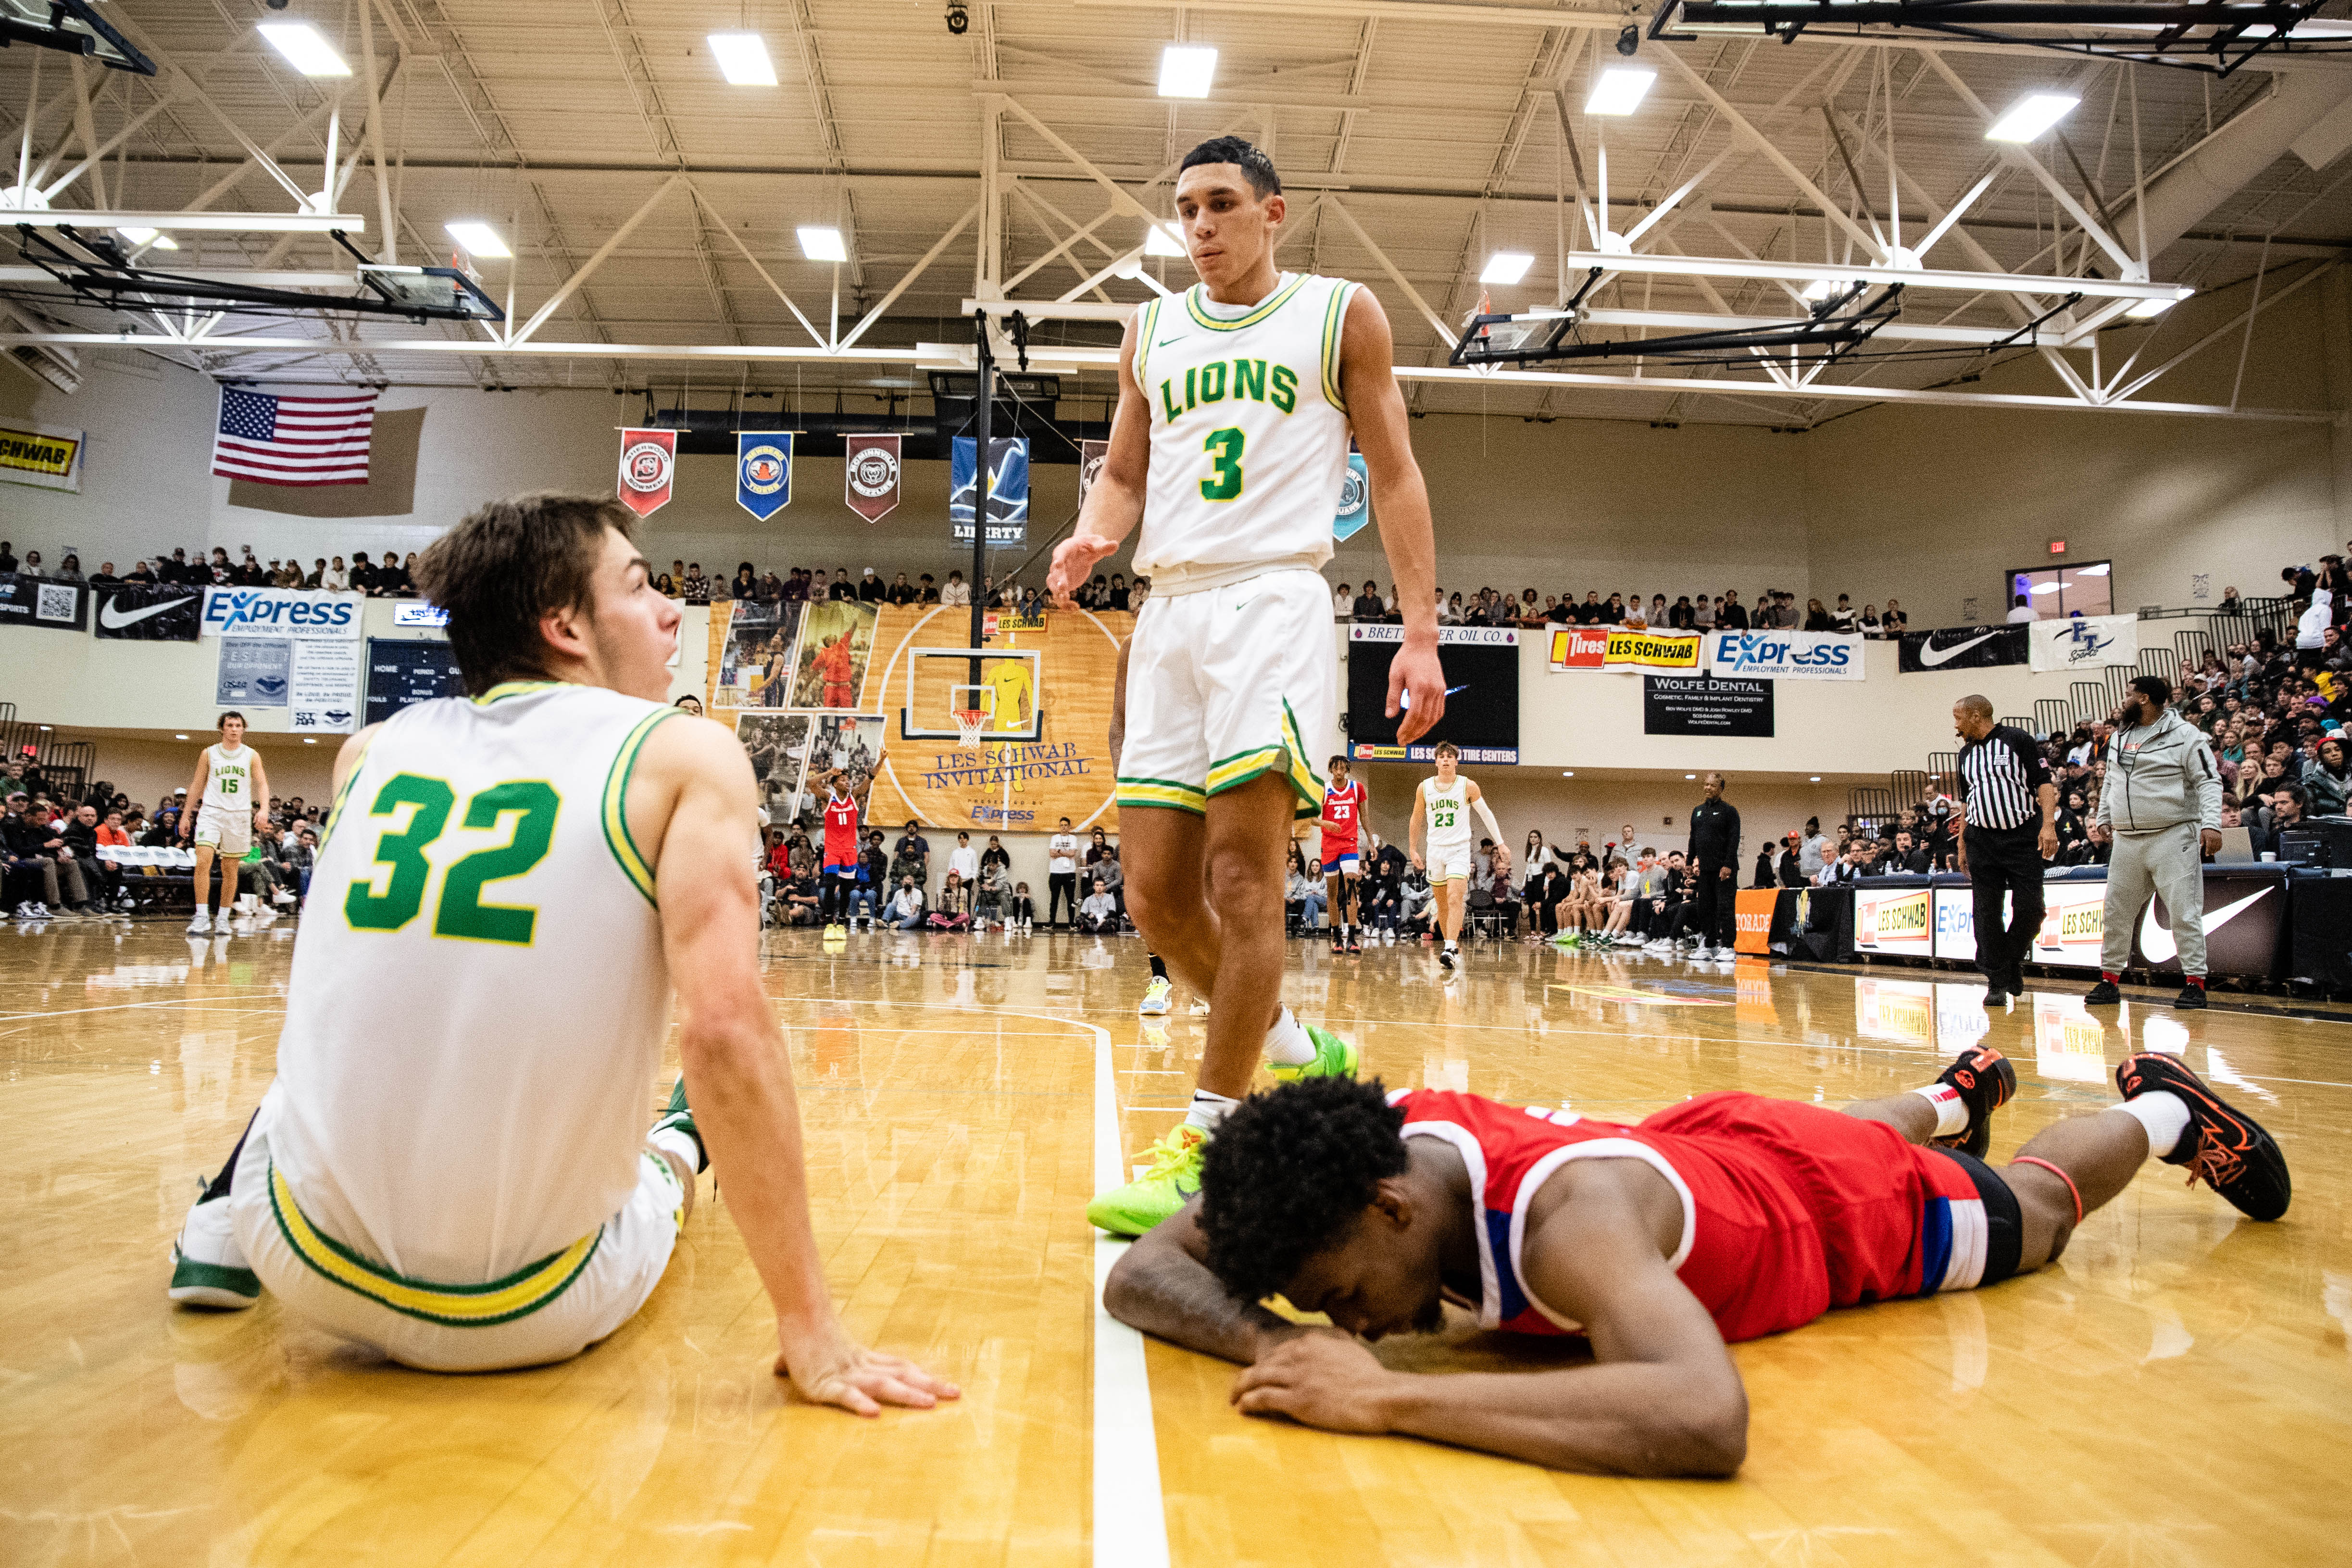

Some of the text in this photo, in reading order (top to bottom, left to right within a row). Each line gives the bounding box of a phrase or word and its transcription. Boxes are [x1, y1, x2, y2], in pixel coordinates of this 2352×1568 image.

[1160, 359, 1299, 424] LIONS
[1199, 426, 1246, 502] 3
[999, 619, 1011, 628] LES
[1012, 617, 1045, 628] SCHWAB
[1459, 629, 1479, 640] OIL
[1484, 630, 1502, 642] CO.
[1570, 632, 1693, 659] Tires LES SCHWAB
[1654, 678, 1764, 692] WOLFE DENTAL
[937, 742, 1077, 769] LES SCHWAB
[1360, 746, 1373, 755] Tires
[1411, 747, 1425, 759] LES
[1463, 749, 1481, 761] TIRE
[1481, 750, 1516, 762] CENTERS
[215, 765, 245, 777] LIONS
[922, 758, 1091, 789] INVITATIONAL
[221, 778, 238, 792] 15
[1334, 805, 1351, 819] 23
[1431, 799, 1459, 811] LIONS
[838, 812, 848, 826] 11
[1434, 813, 1454, 828] 23
[343, 771, 563, 947] 32
[1878, 910, 1890, 931] LES
[1892, 903, 1926, 930] SCHWAB
[2063, 914, 2077, 935] LES
